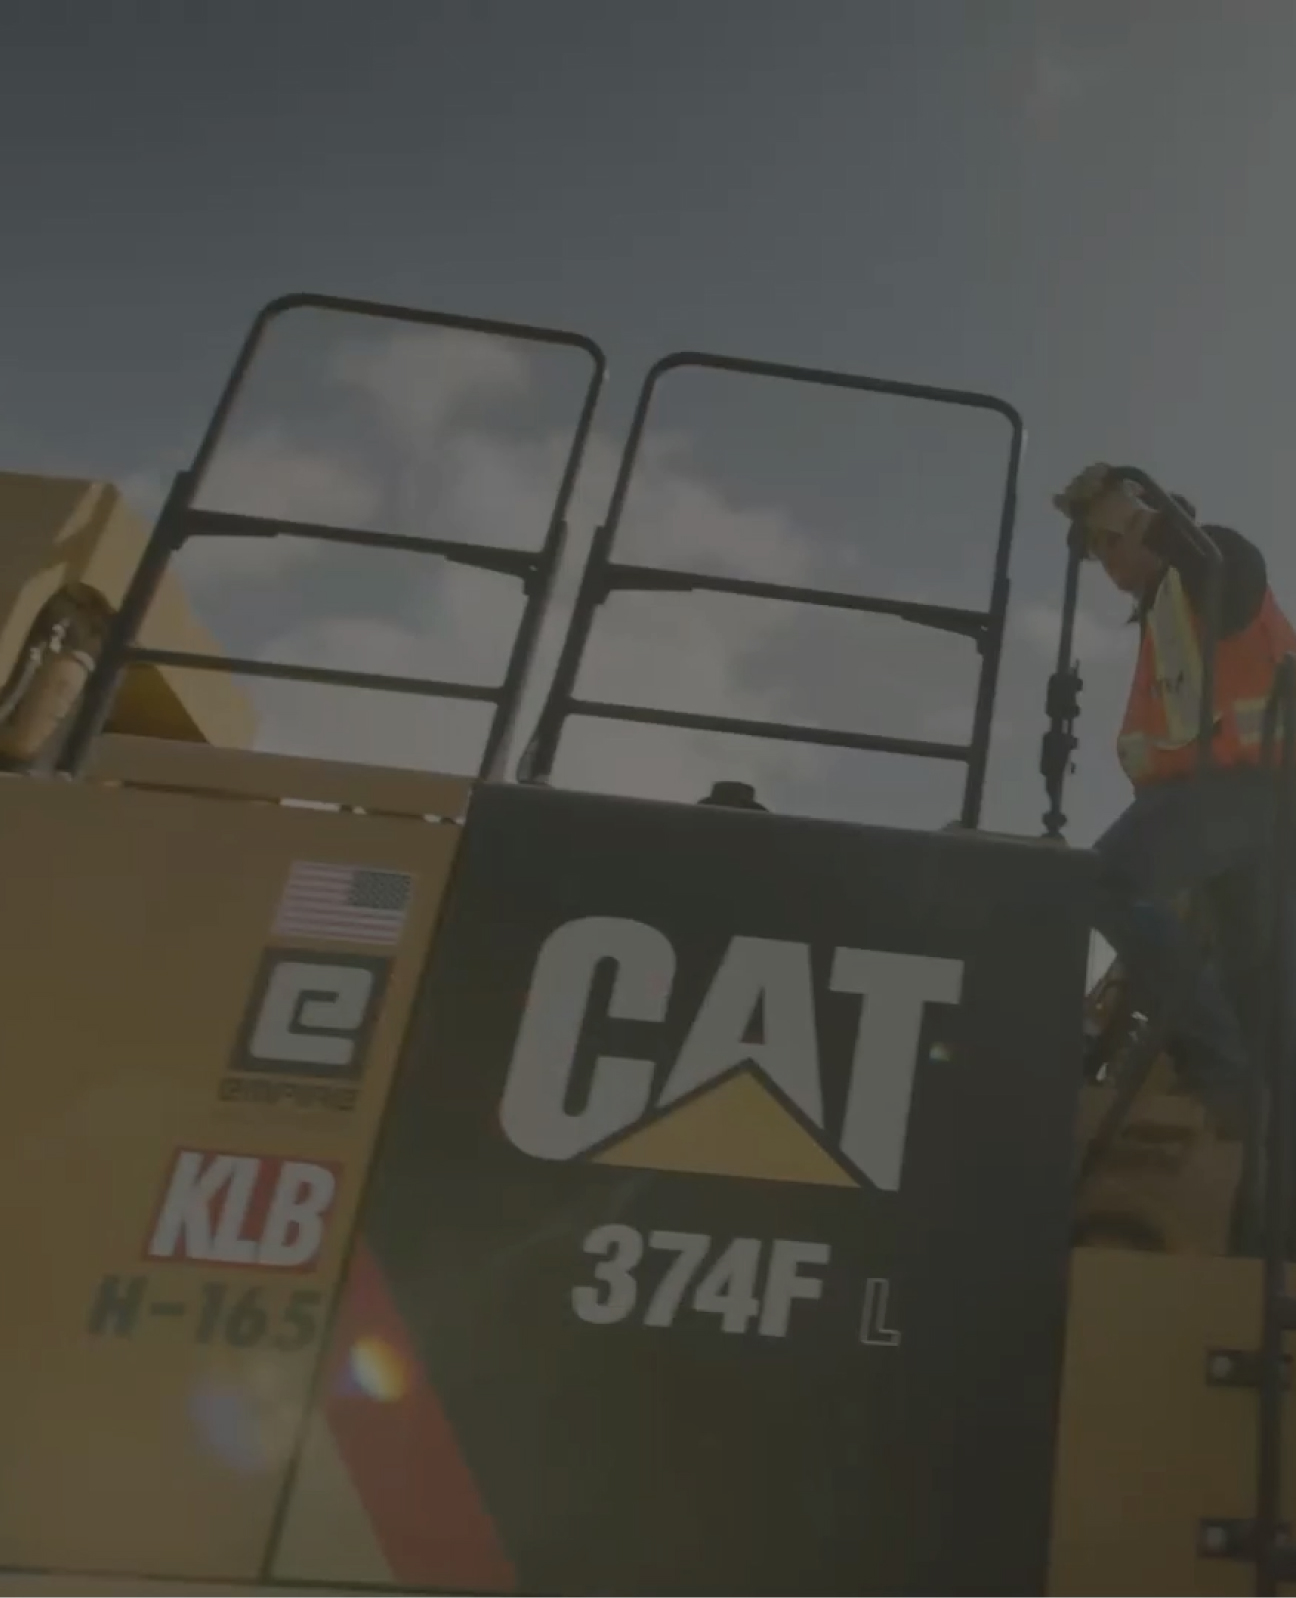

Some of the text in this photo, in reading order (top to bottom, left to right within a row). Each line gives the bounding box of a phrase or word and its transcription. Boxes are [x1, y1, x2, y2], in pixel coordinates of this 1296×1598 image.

[499, 916, 964, 1191] CAT
[149, 1151, 336, 1266] KLB
[88, 1274, 324, 1351] H-165
[572, 1224, 900, 1346] 374F L
